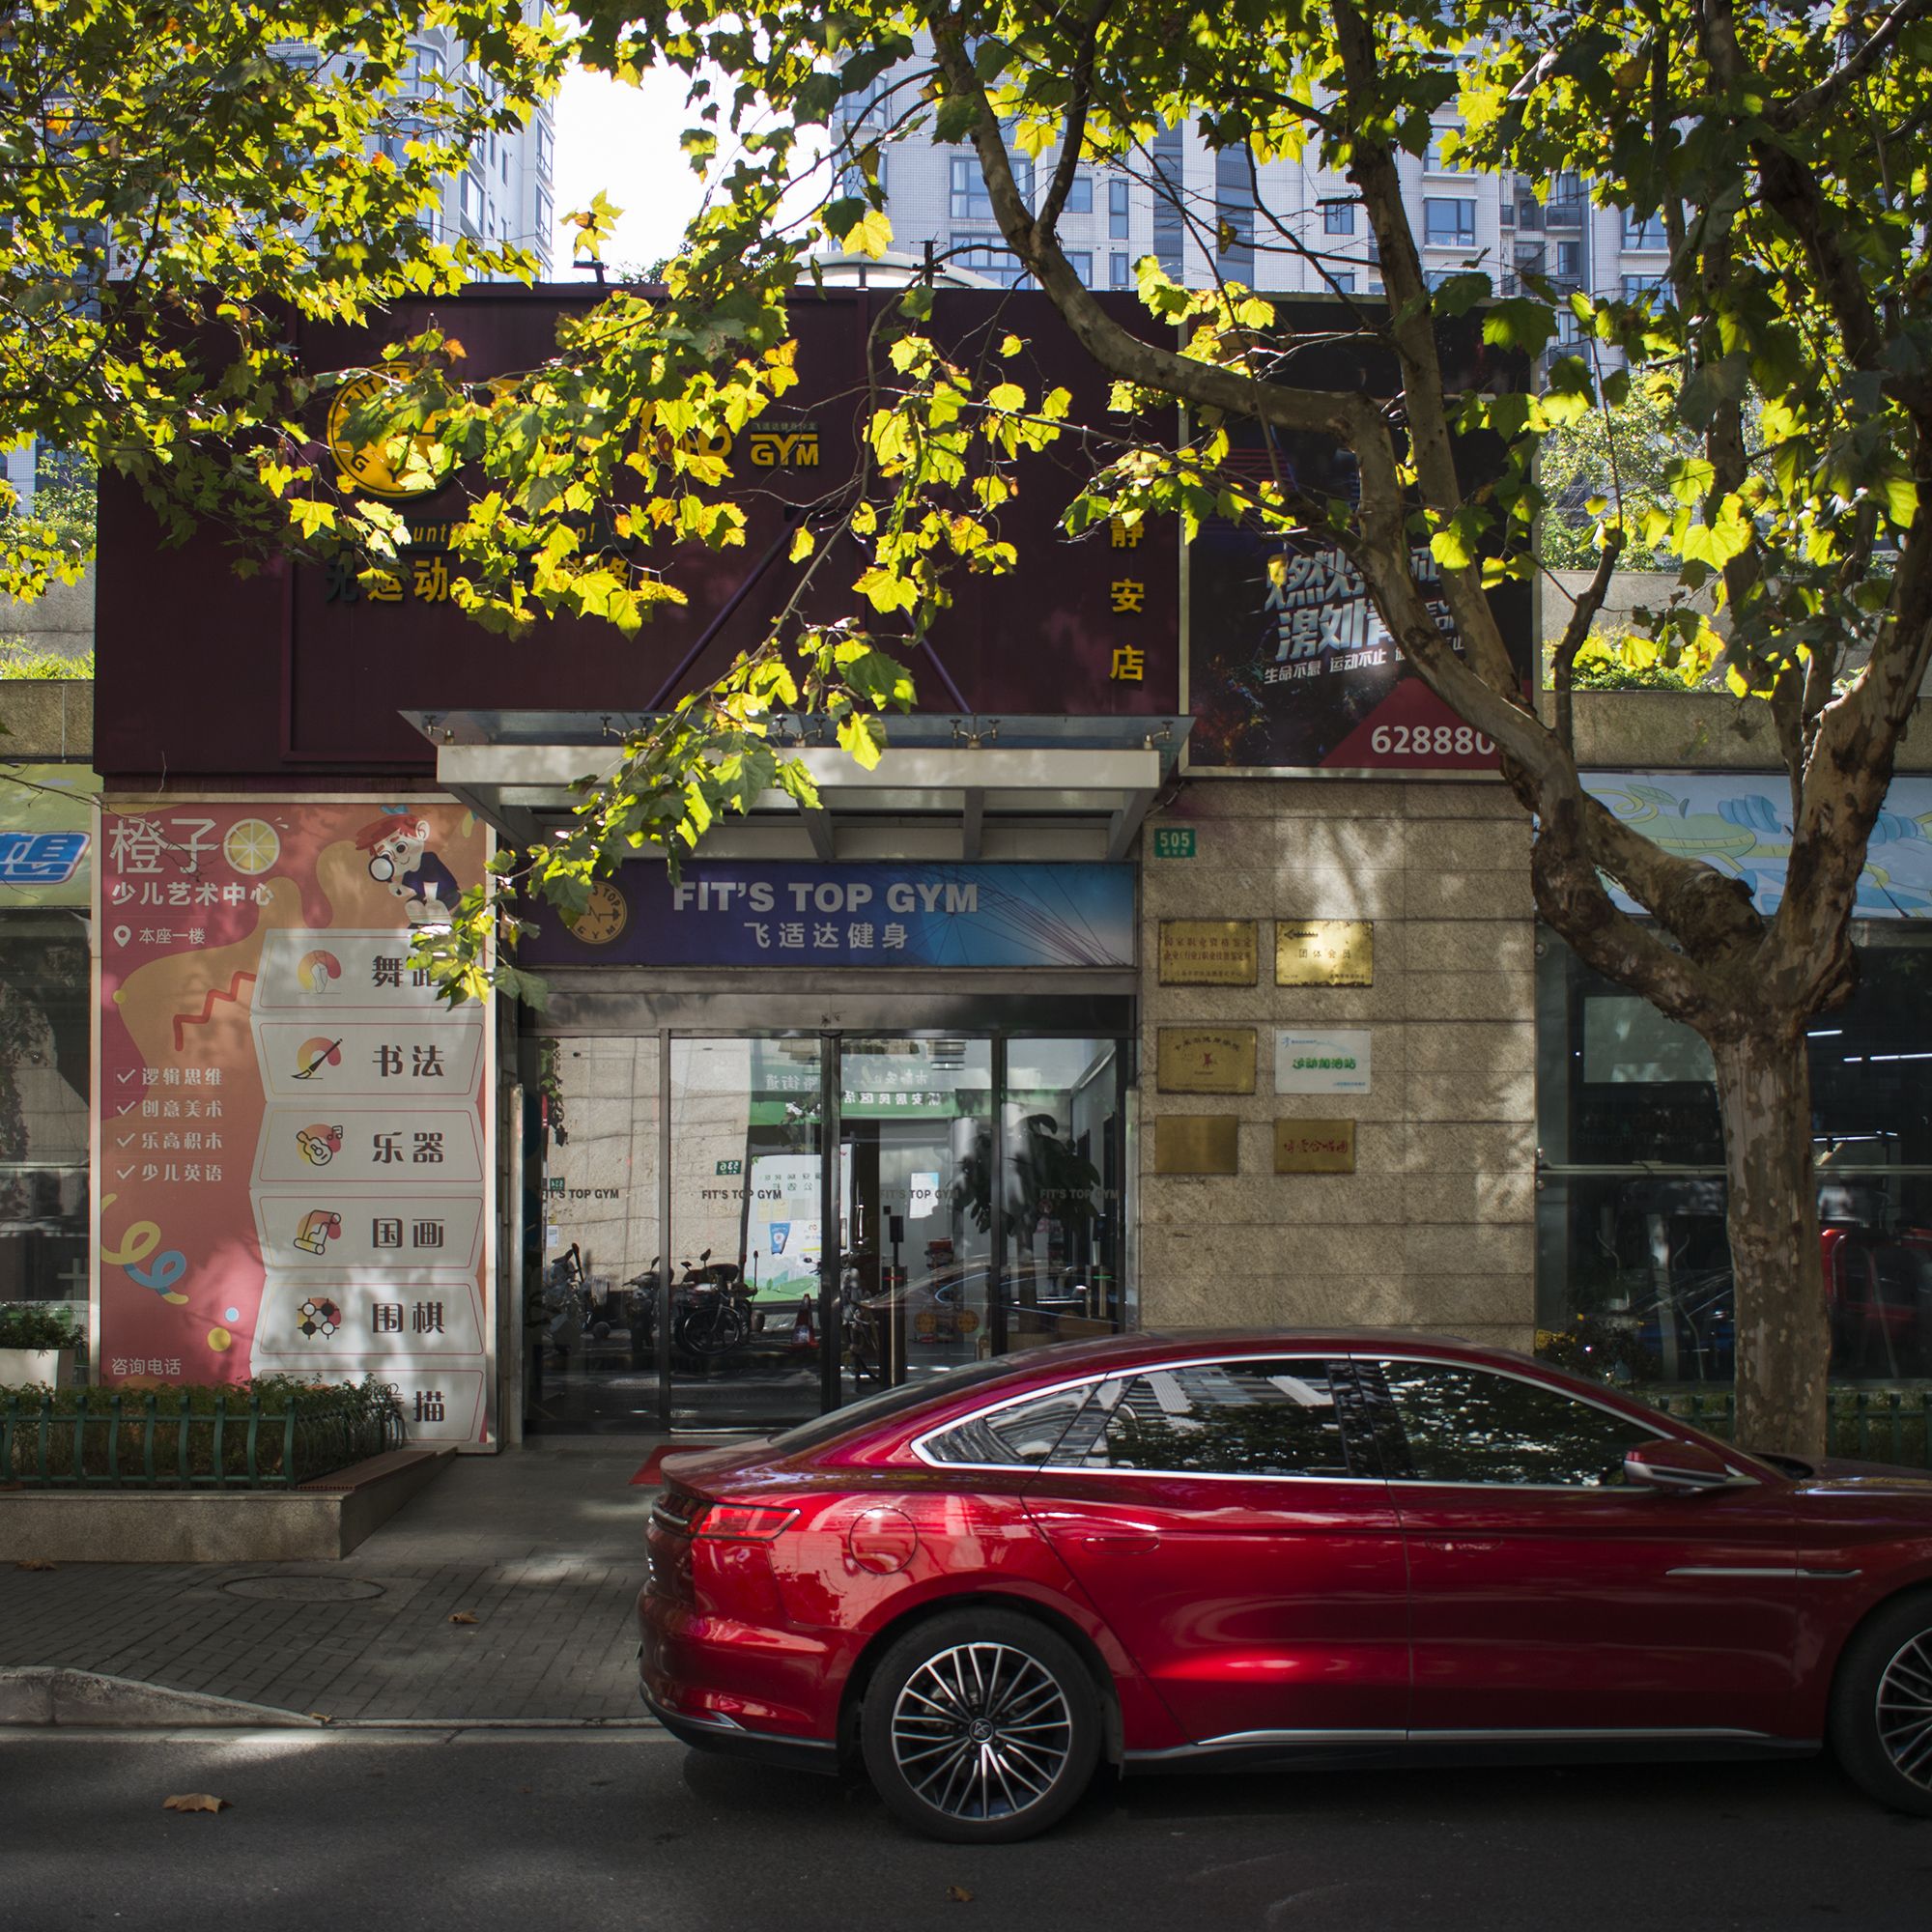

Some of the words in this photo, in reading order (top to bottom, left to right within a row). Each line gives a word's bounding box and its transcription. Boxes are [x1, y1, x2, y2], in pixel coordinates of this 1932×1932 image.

[750, 433, 819, 466] GYM
[1264, 659, 1321, 684] 生命不息
[1329, 648, 1386, 673] 运动不止
[109, 817, 220, 875] 橙子
[1159, 832, 1190, 848] 505
[111, 881, 274, 906] 少儿艺术中心
[673, 882, 775, 913] FIT'S
[788, 882, 872, 914] TOP
[886, 882, 979, 914] GYM
[139, 927, 206, 945] 本座一楼
[744, 922, 909, 951] 飞适达健身
[1298, 948, 1351, 959] 团体会员
[372, 1044, 444, 1078] 书法
[142, 1068, 224, 1087] 逻辑思维
[142, 1099, 224, 1119] 创意美术
[142, 1132, 224, 1151] 乐高积木
[372, 1131, 444, 1165] 乐器
[142, 1164, 224, 1182] 少儿英语
[569, 1189, 591, 1199] TOP
[595, 1189, 619, 1199] GYM
[702, 1189, 728, 1200] FIT'S
[758, 1189, 781, 1200] GYM
[910, 1189, 931, 1200] TOP
[372, 1217, 445, 1249] 国画
[372, 1301, 445, 1335] 围棋
[111, 1357, 182, 1377] 咨询电话
